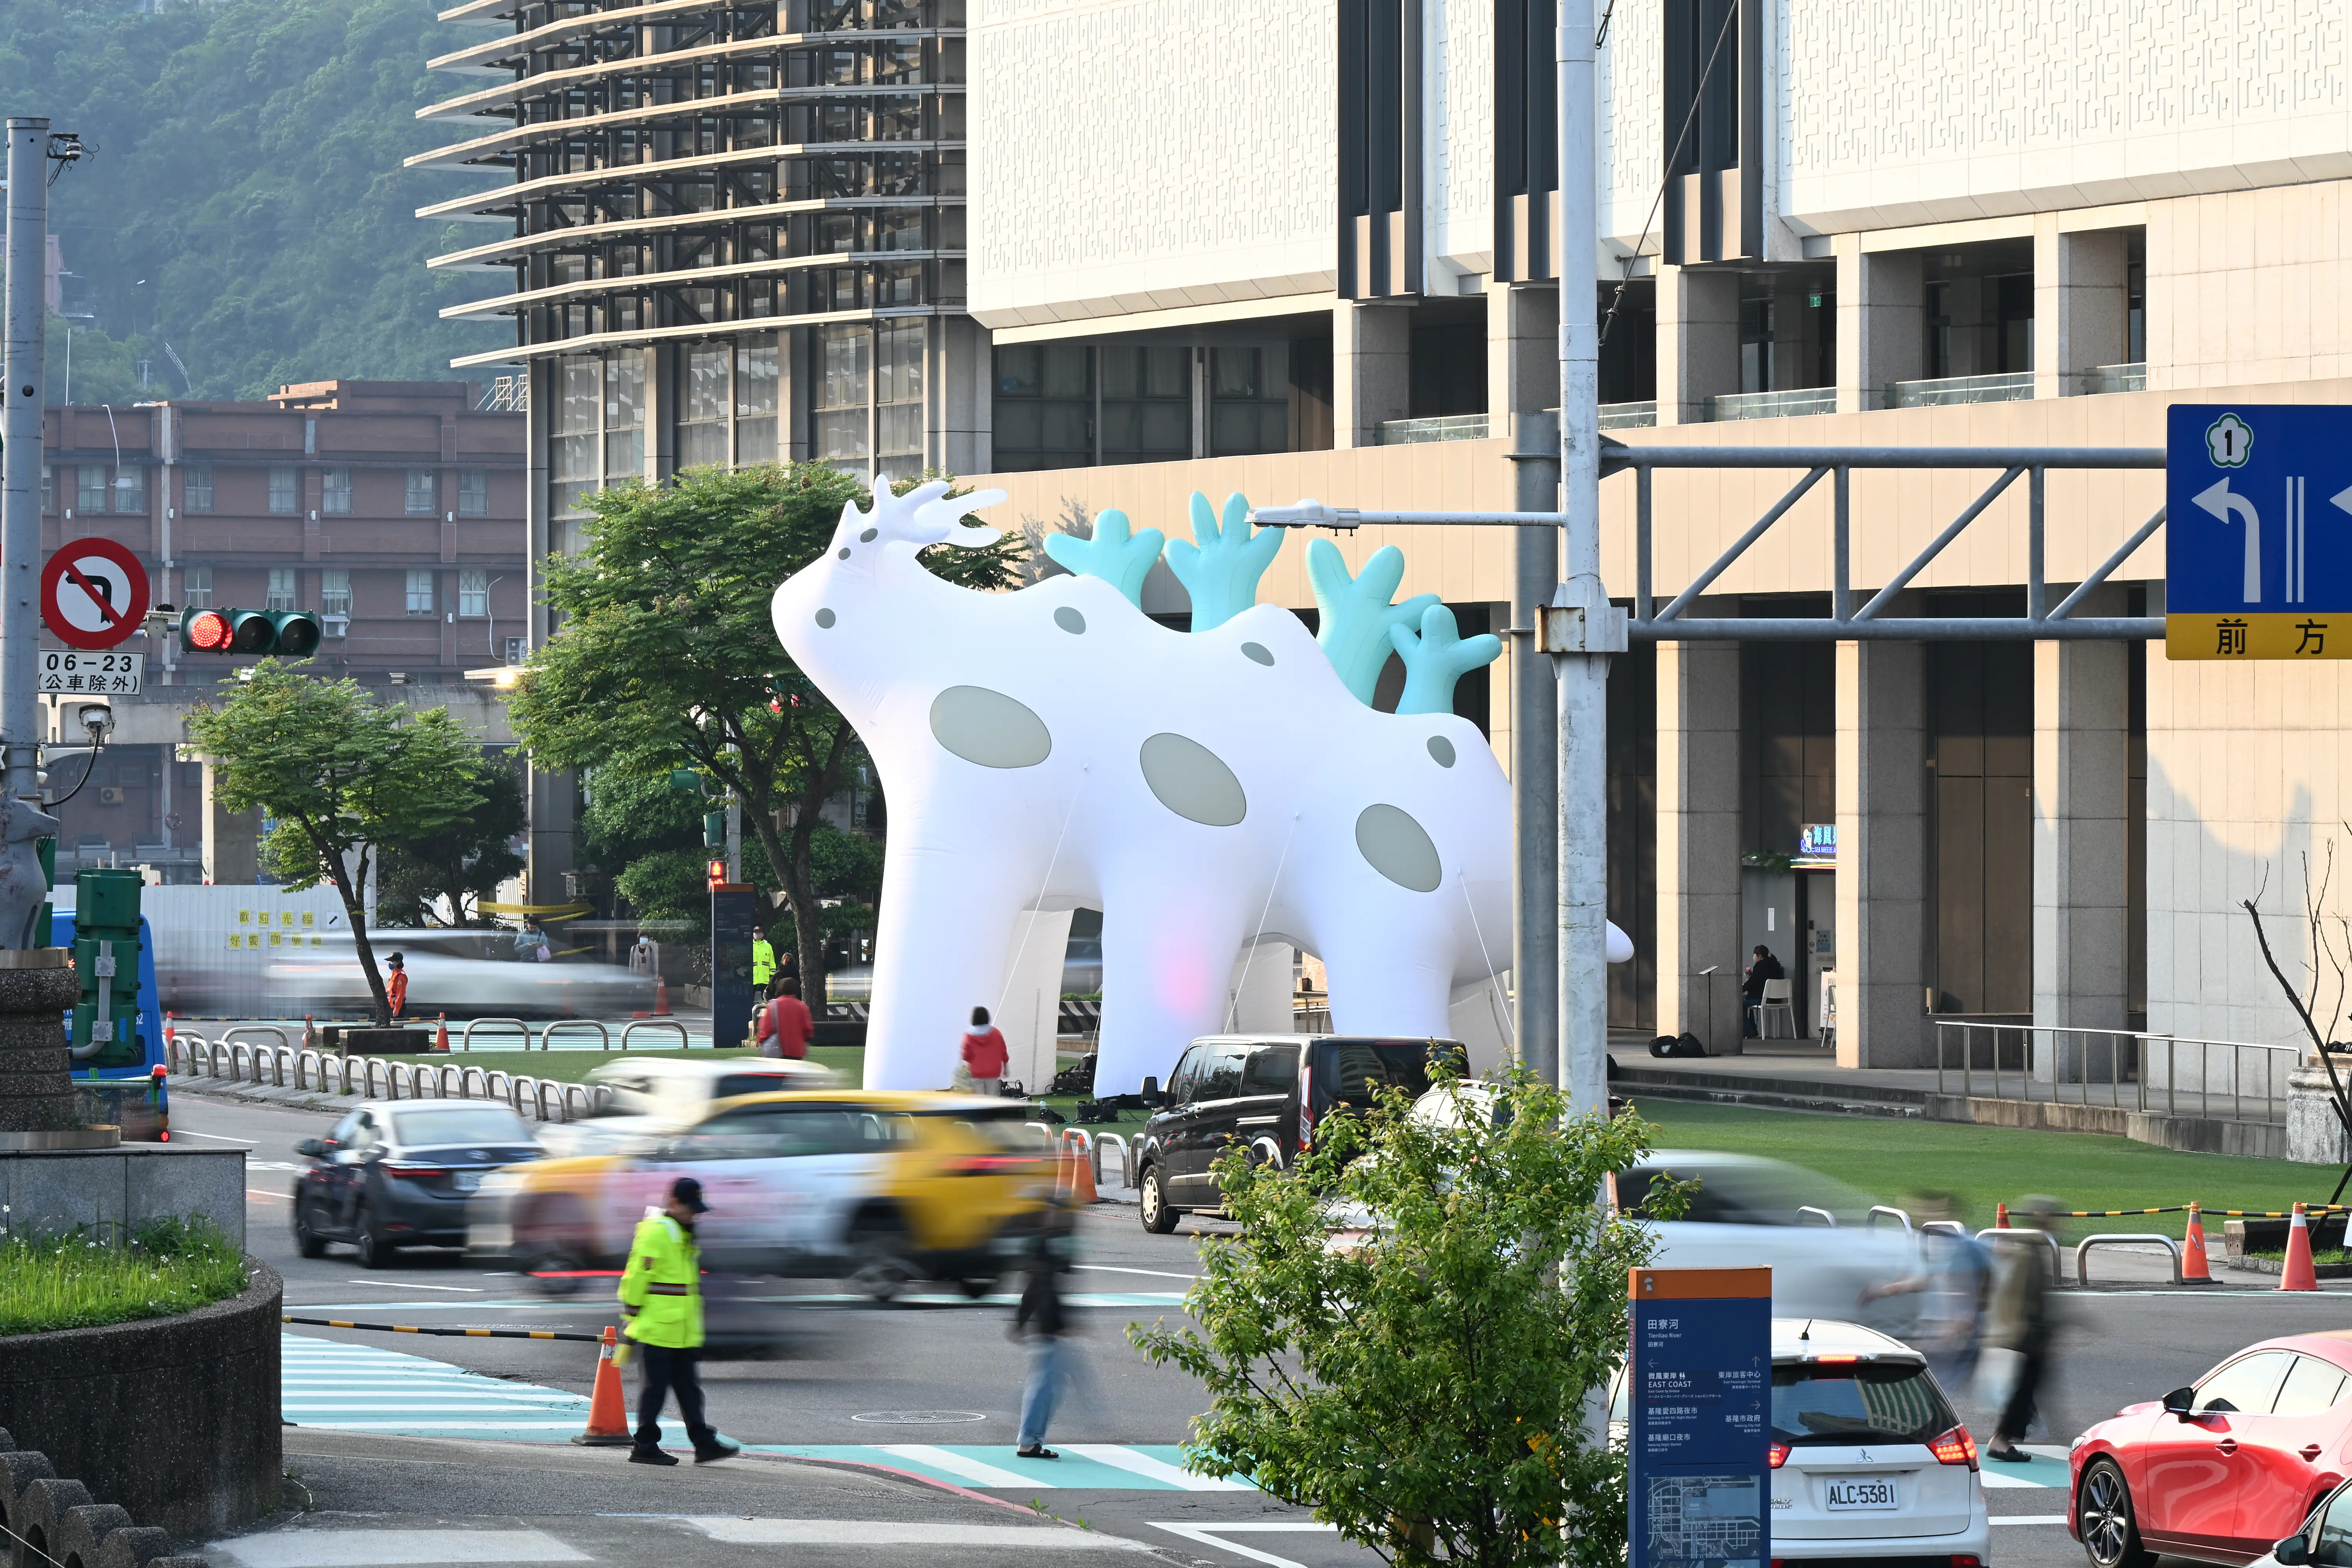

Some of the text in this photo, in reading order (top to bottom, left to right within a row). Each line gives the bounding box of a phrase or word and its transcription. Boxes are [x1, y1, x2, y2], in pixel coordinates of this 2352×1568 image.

[2224, 430, 2232, 456] 1
[2216, 618, 2328, 655] 前方
[46, 654, 132, 672] 06-23
[38, 673, 137, 692] (公車除外)
[1648, 1319, 1678, 1329] 田寮河
[1648, 1407, 1698, 1415] 基隆愛四路夜市
